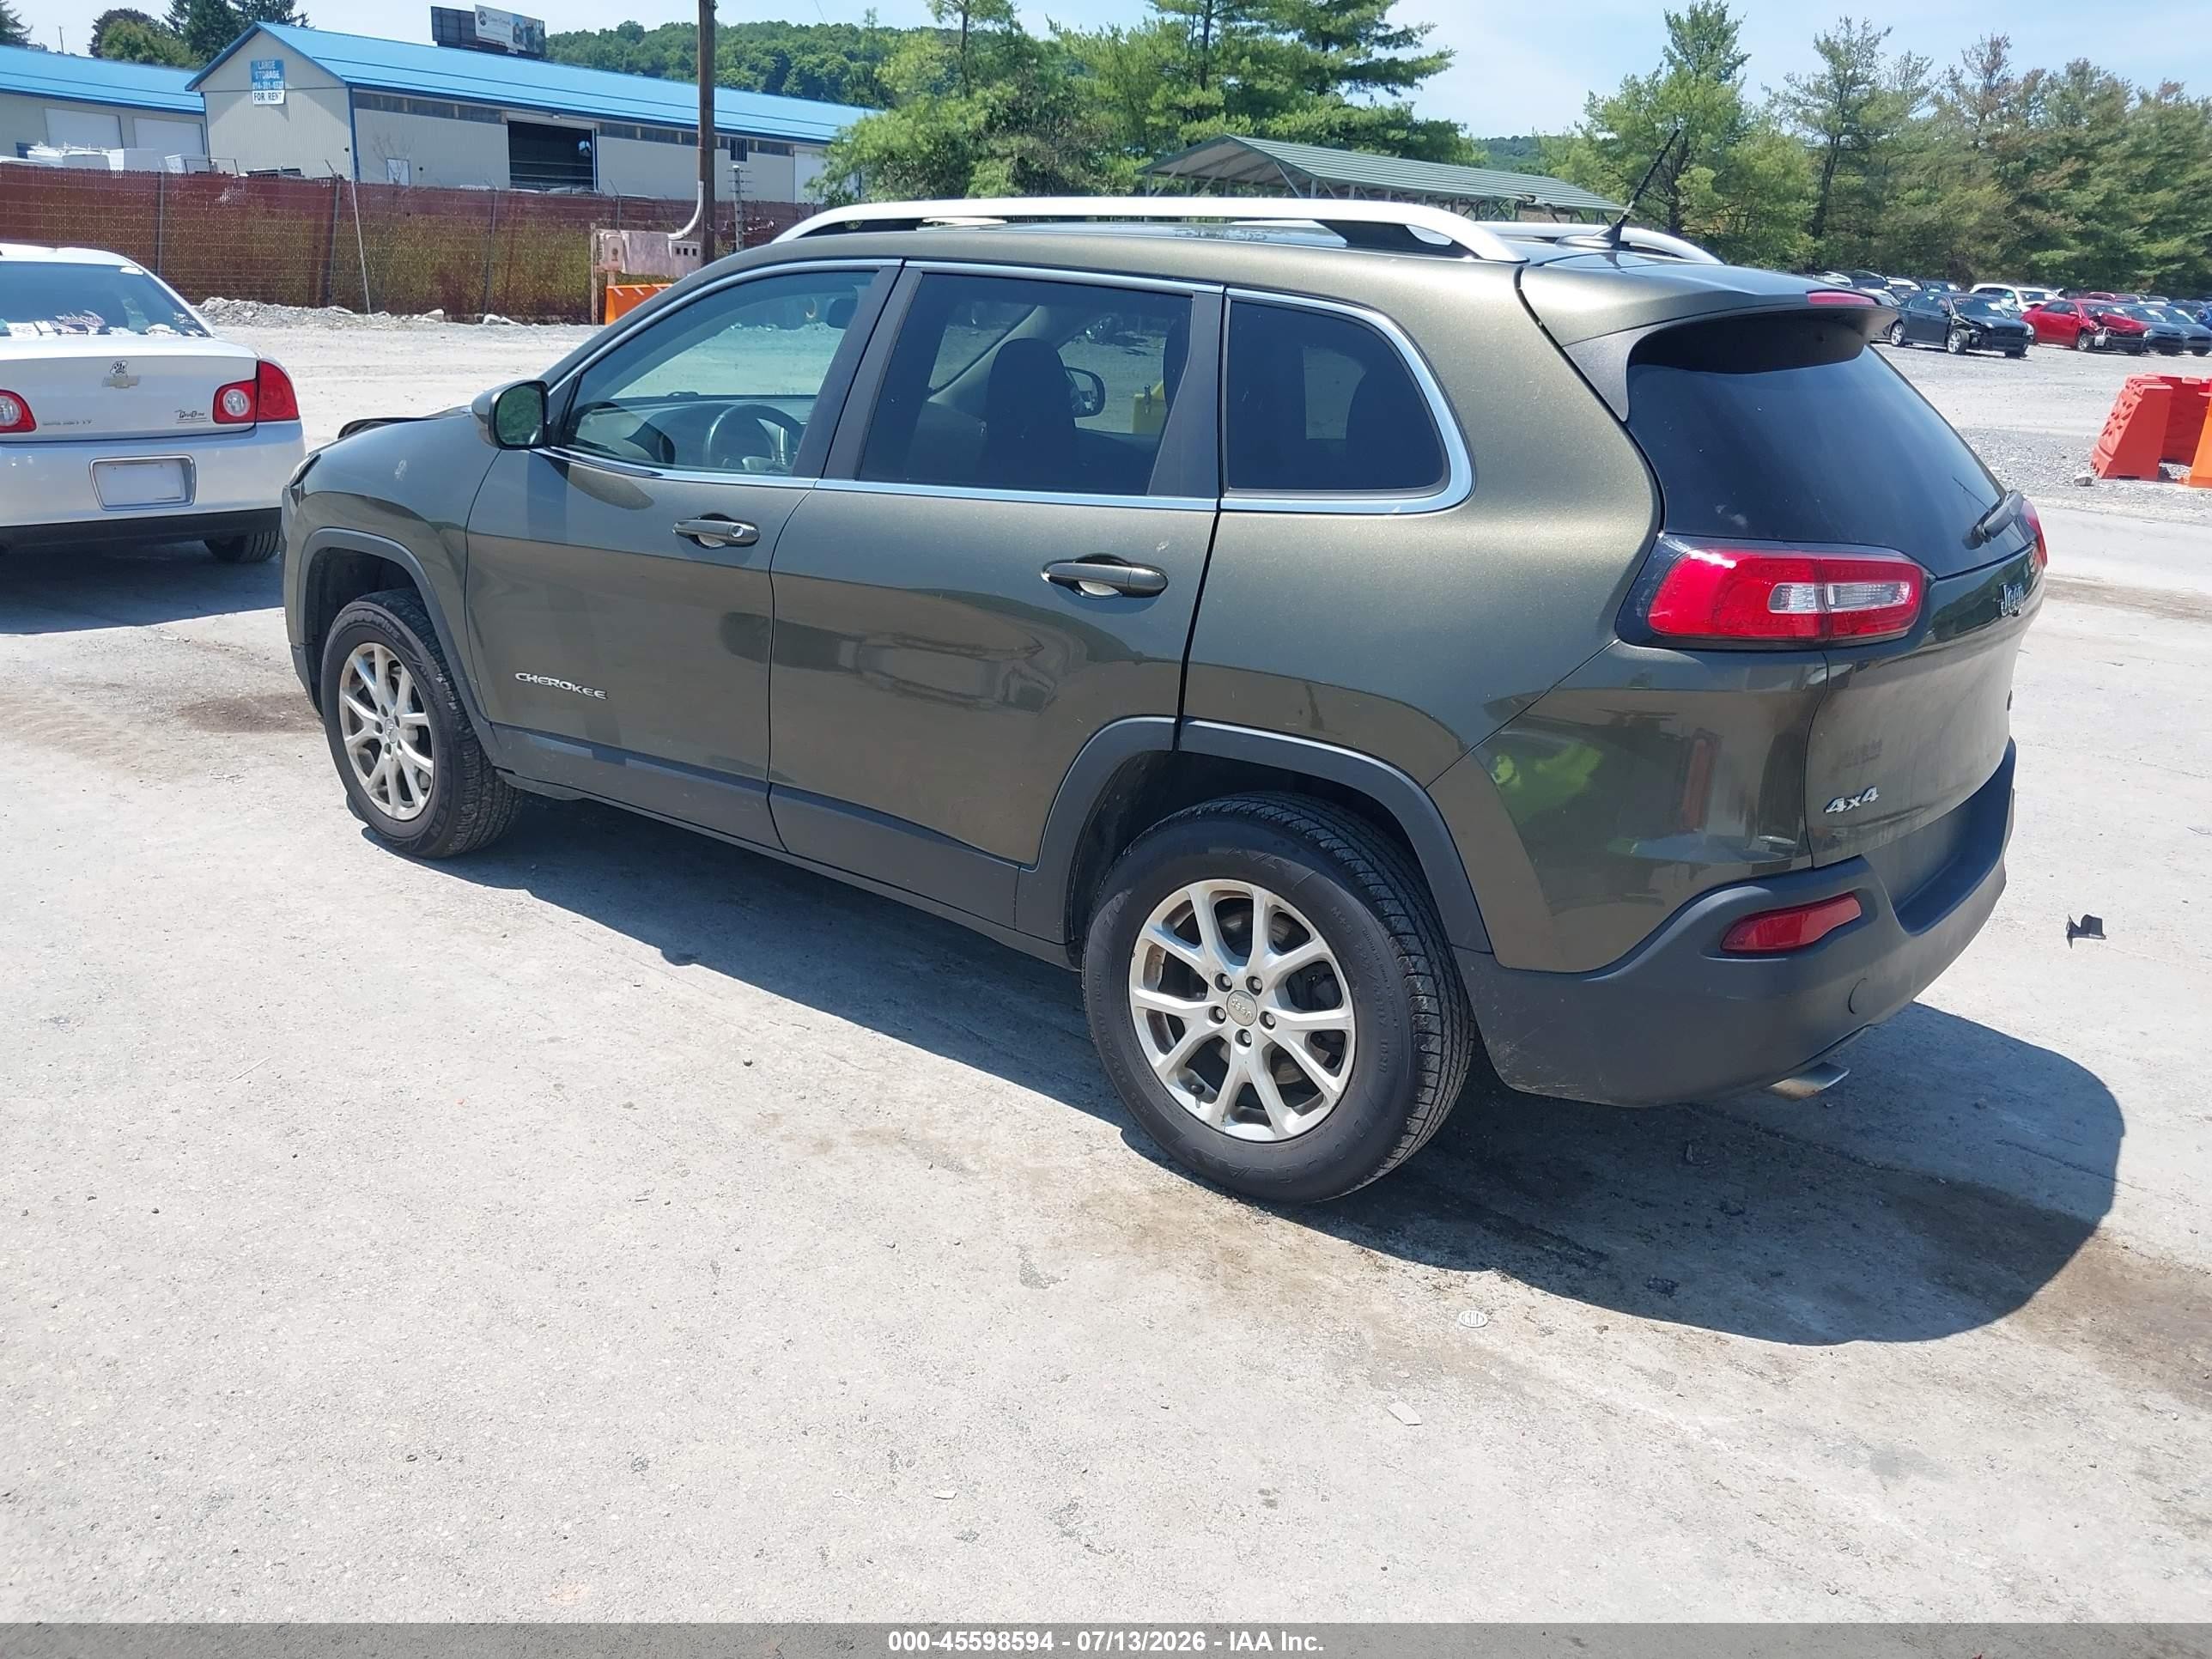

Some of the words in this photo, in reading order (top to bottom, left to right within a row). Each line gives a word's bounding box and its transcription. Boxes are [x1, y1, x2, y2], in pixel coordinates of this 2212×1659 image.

[255, 70, 280, 79] STORAGE
[253, 92, 265, 101] FOR
[268, 92, 282, 101] RENT
[1999, 583, 2025, 617] Jeep
[514, 672, 607, 700] CHEROKEE
[1824, 787, 1879, 814] 4x4
